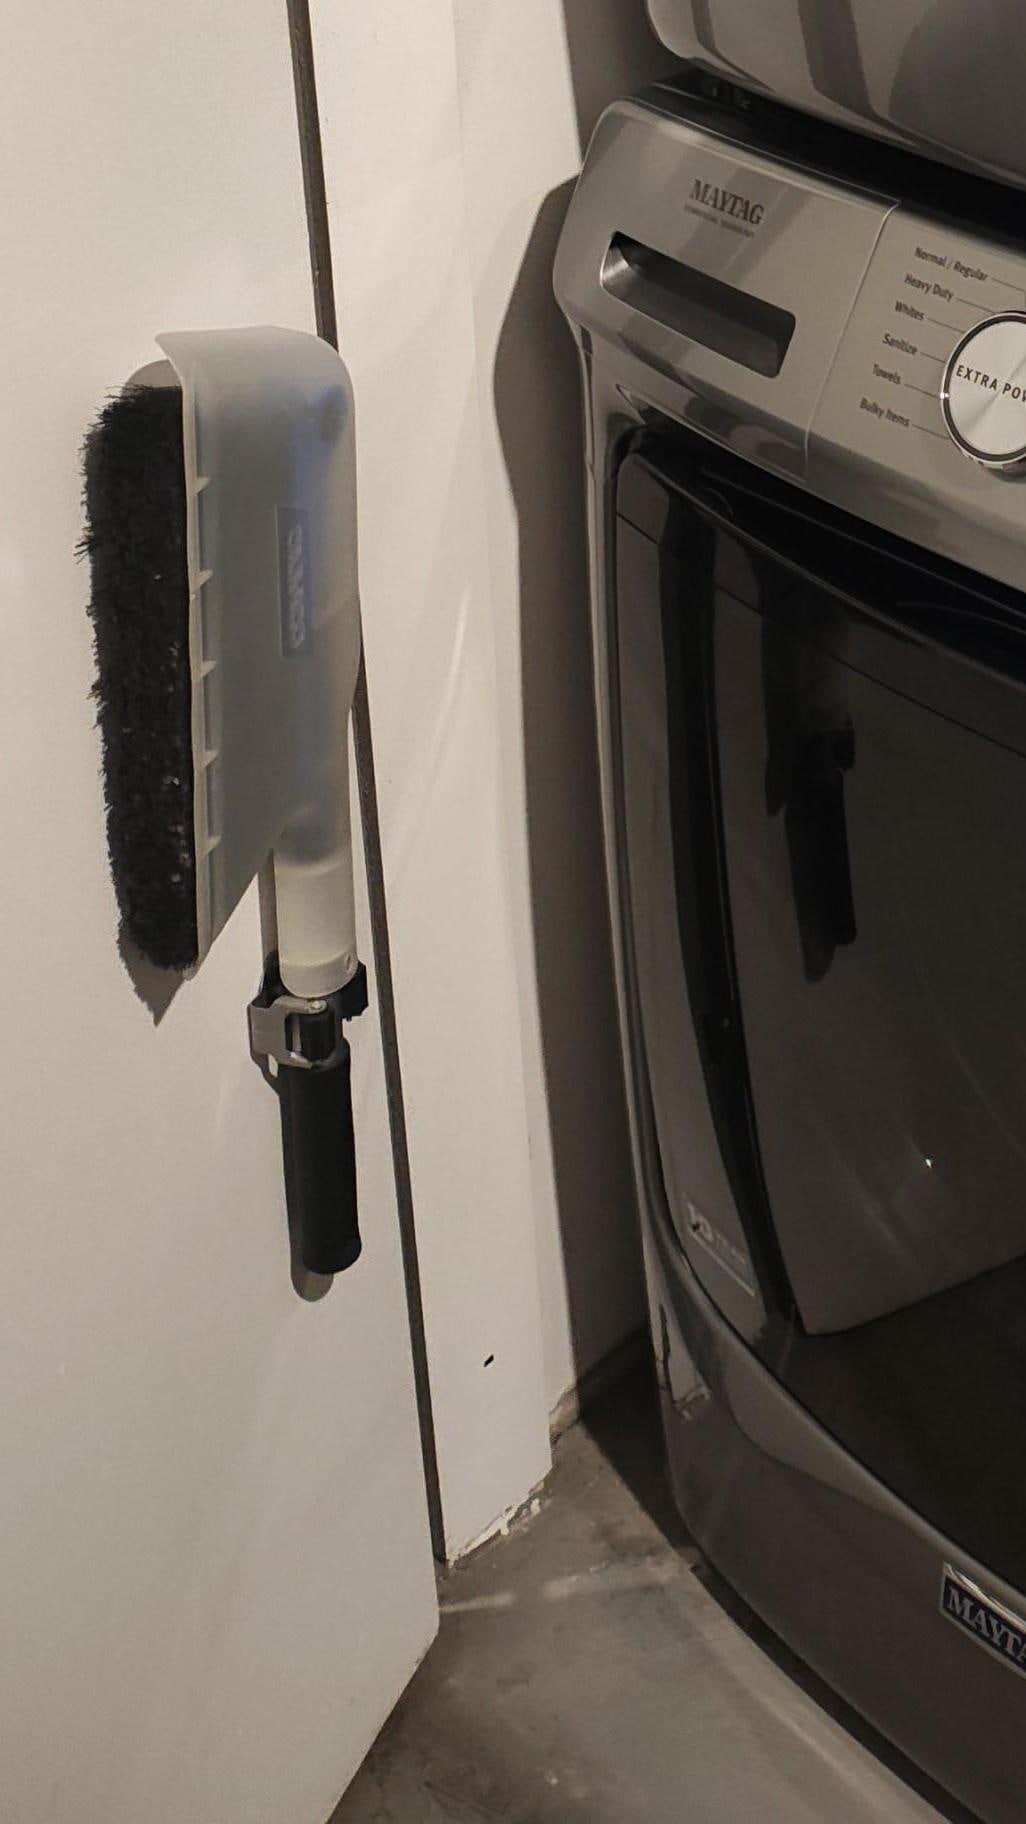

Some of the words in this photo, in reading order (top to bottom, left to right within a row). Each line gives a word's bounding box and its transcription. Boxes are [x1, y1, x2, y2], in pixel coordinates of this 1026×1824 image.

[689, 178, 765, 226] MAYTAG
[914, 246, 946, 268] Normal
[953, 260, 989, 282] Regular
[904, 273, 932, 295] Heavy
[932, 283, 955, 302] Duty
[895, 300, 926, 322] Whites
[882, 332, 918, 355] Sanitize
[873, 363, 902, 386] Towels
[956, 364, 999, 392] EXTRA
[859, 397, 885, 419] Bulky
[885, 408, 910, 428] Items
